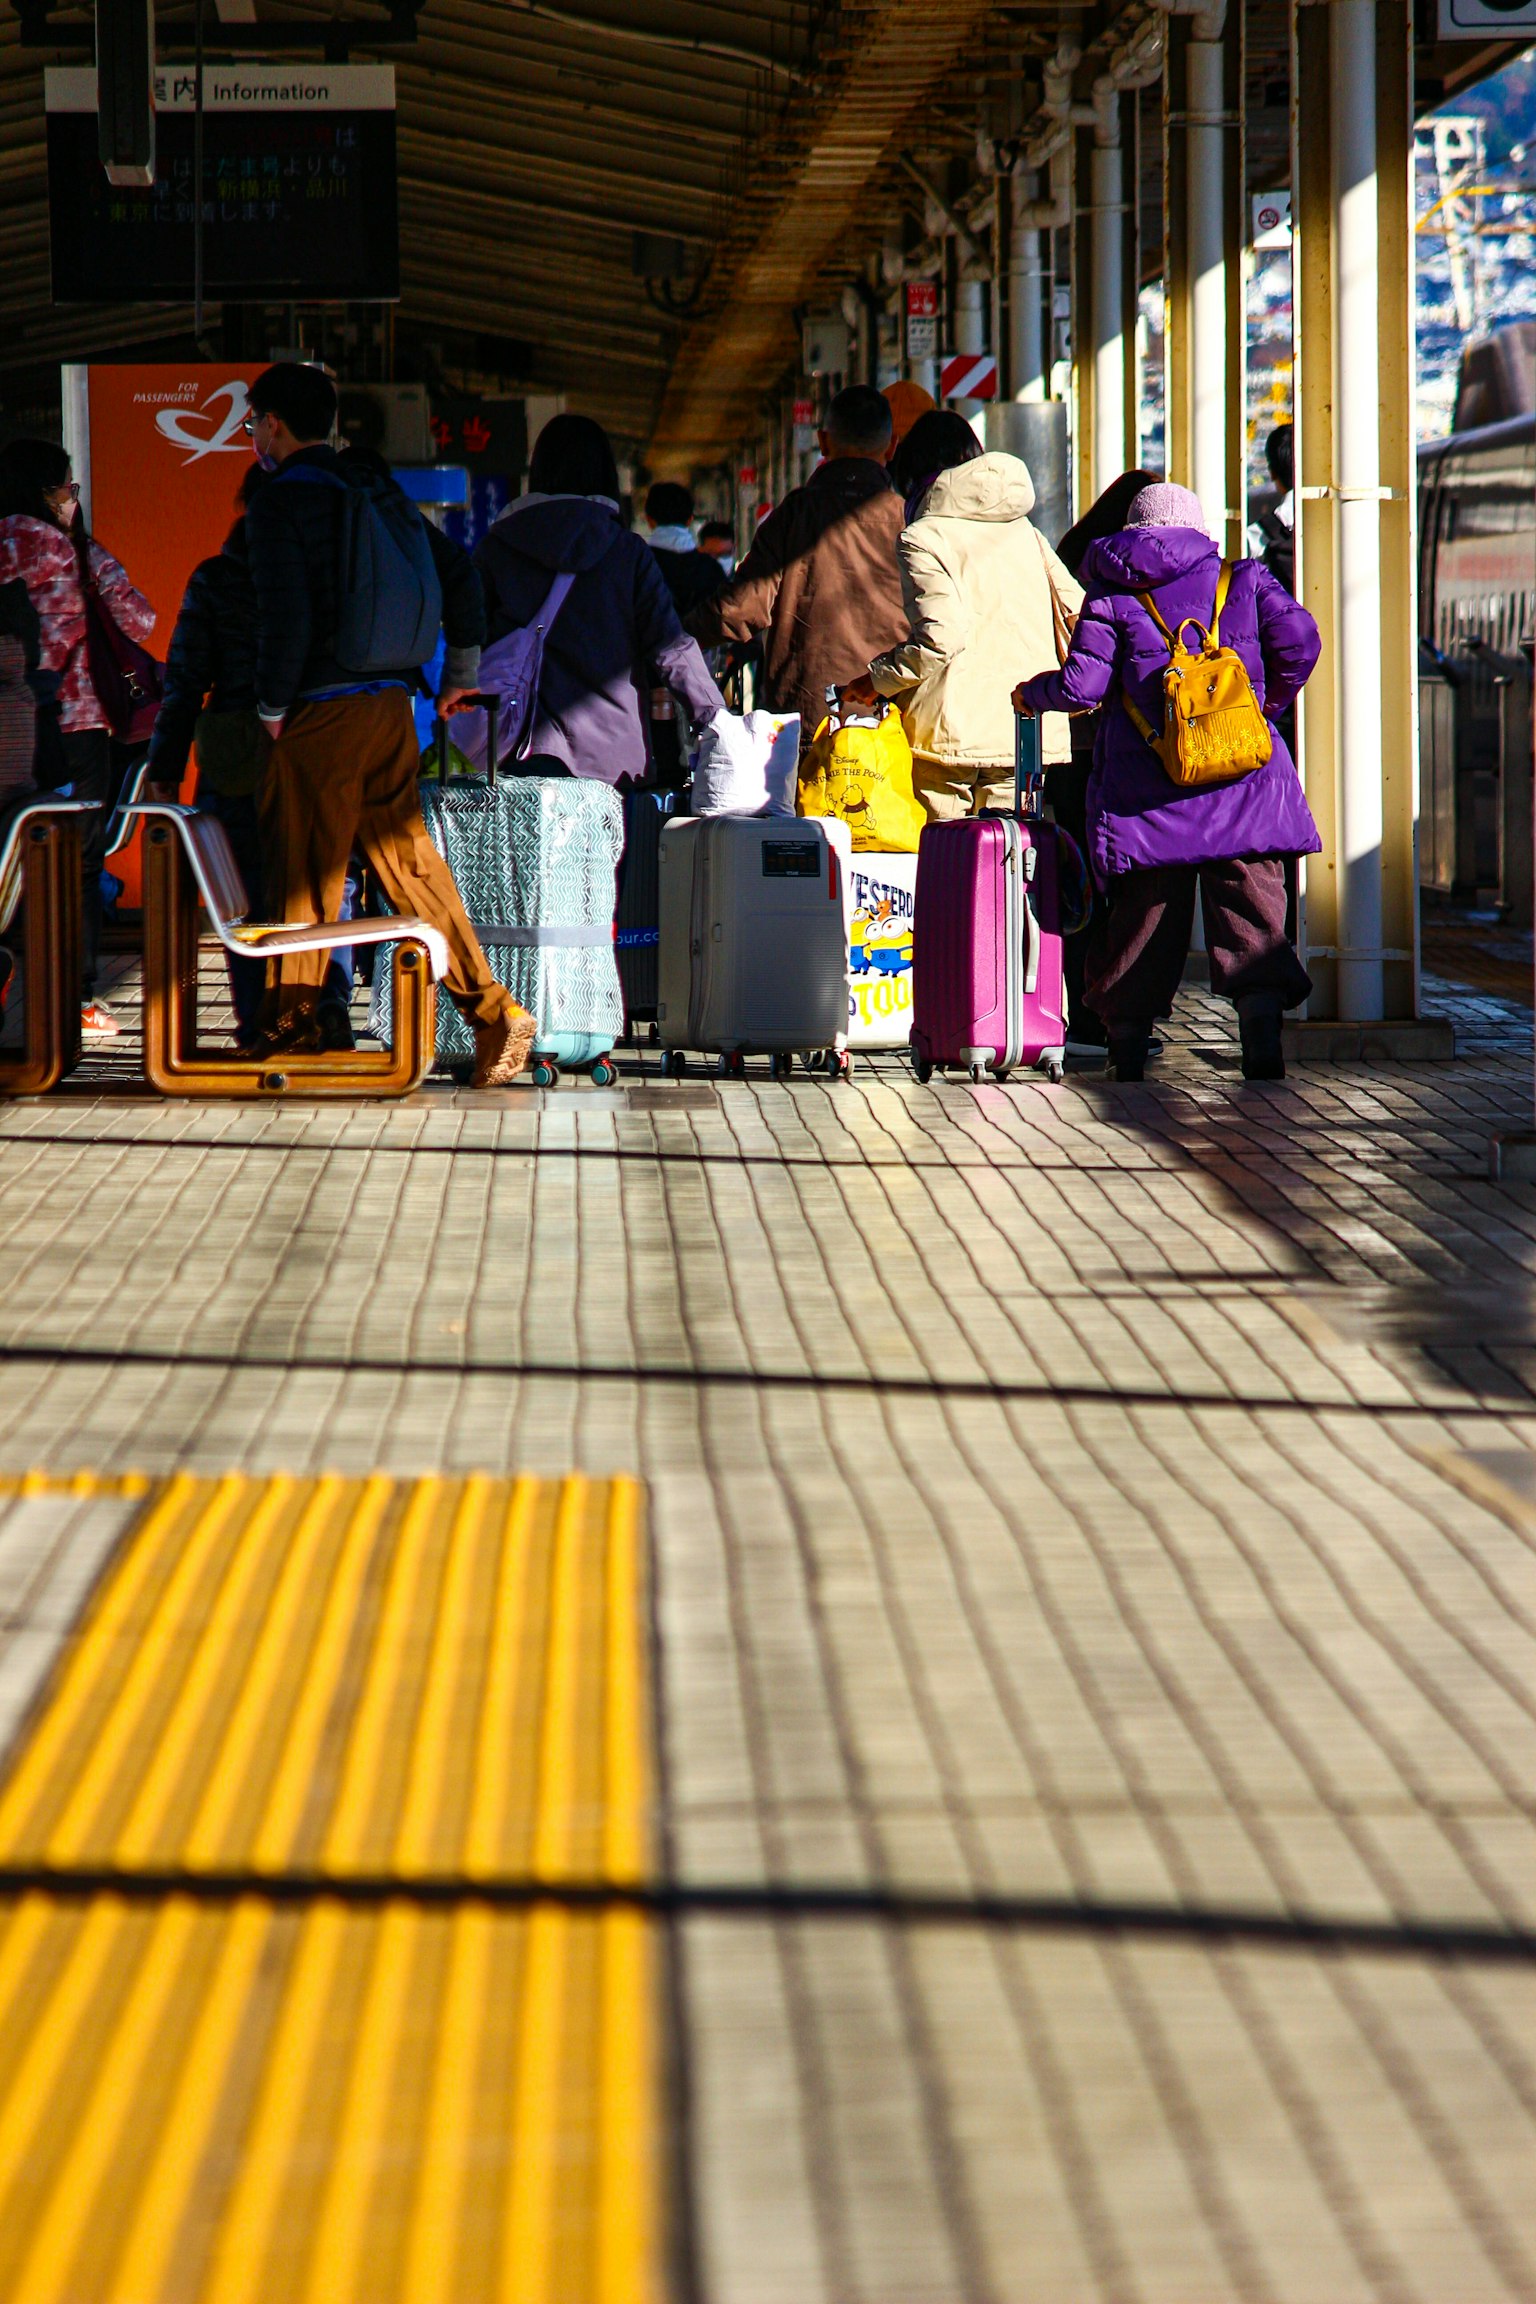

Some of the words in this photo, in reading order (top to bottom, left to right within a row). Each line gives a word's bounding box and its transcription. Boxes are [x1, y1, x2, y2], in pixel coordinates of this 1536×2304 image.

[214, 83, 328, 100] Information
[178, 382, 199, 392] FOR
[132, 392, 196, 403] PASSENGERS
[810, 769, 840, 786] WINNIE
[842, 768, 861, 776] THE
[862, 768, 885, 783] POOH
[850, 871, 913, 918] ESTERD
